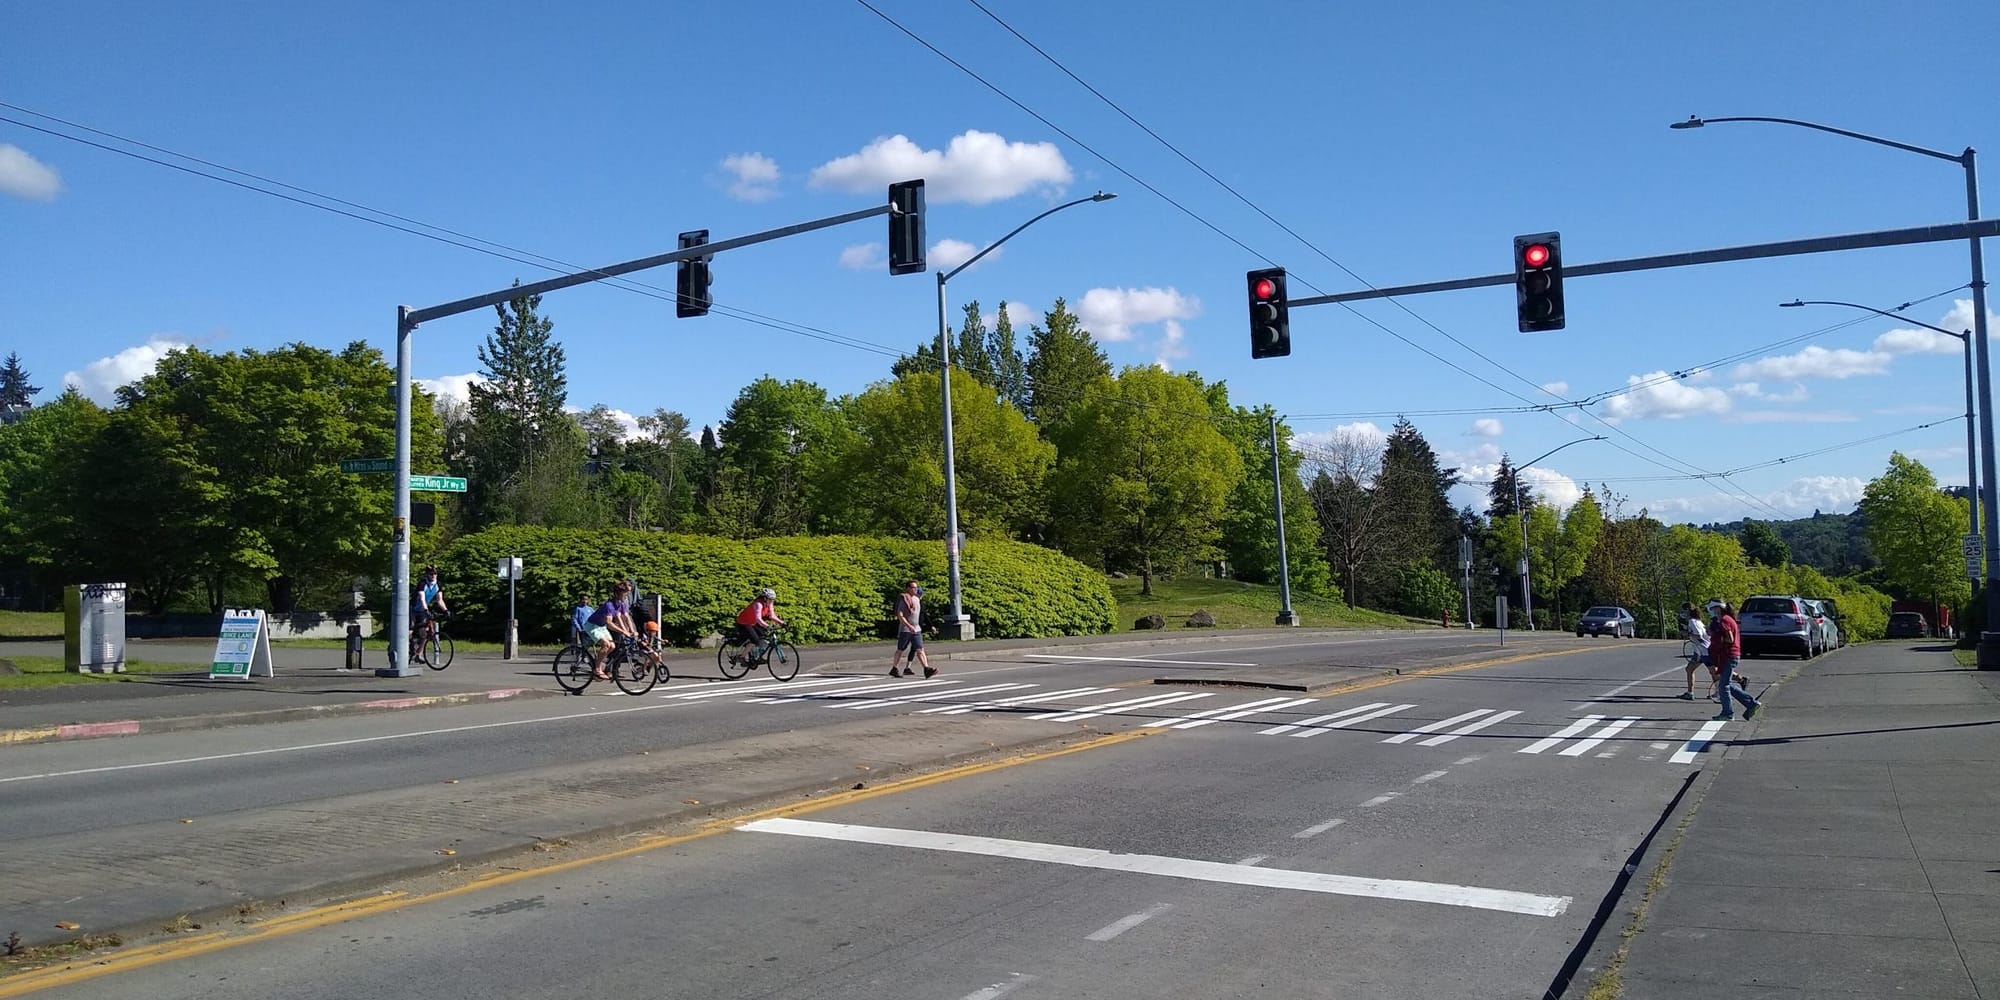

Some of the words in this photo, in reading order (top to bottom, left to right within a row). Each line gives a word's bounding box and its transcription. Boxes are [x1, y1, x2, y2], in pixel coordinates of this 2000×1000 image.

[425, 476, 440, 490] King
[442, 478, 449, 488] Jr
[1966, 546, 1981, 556] 25
